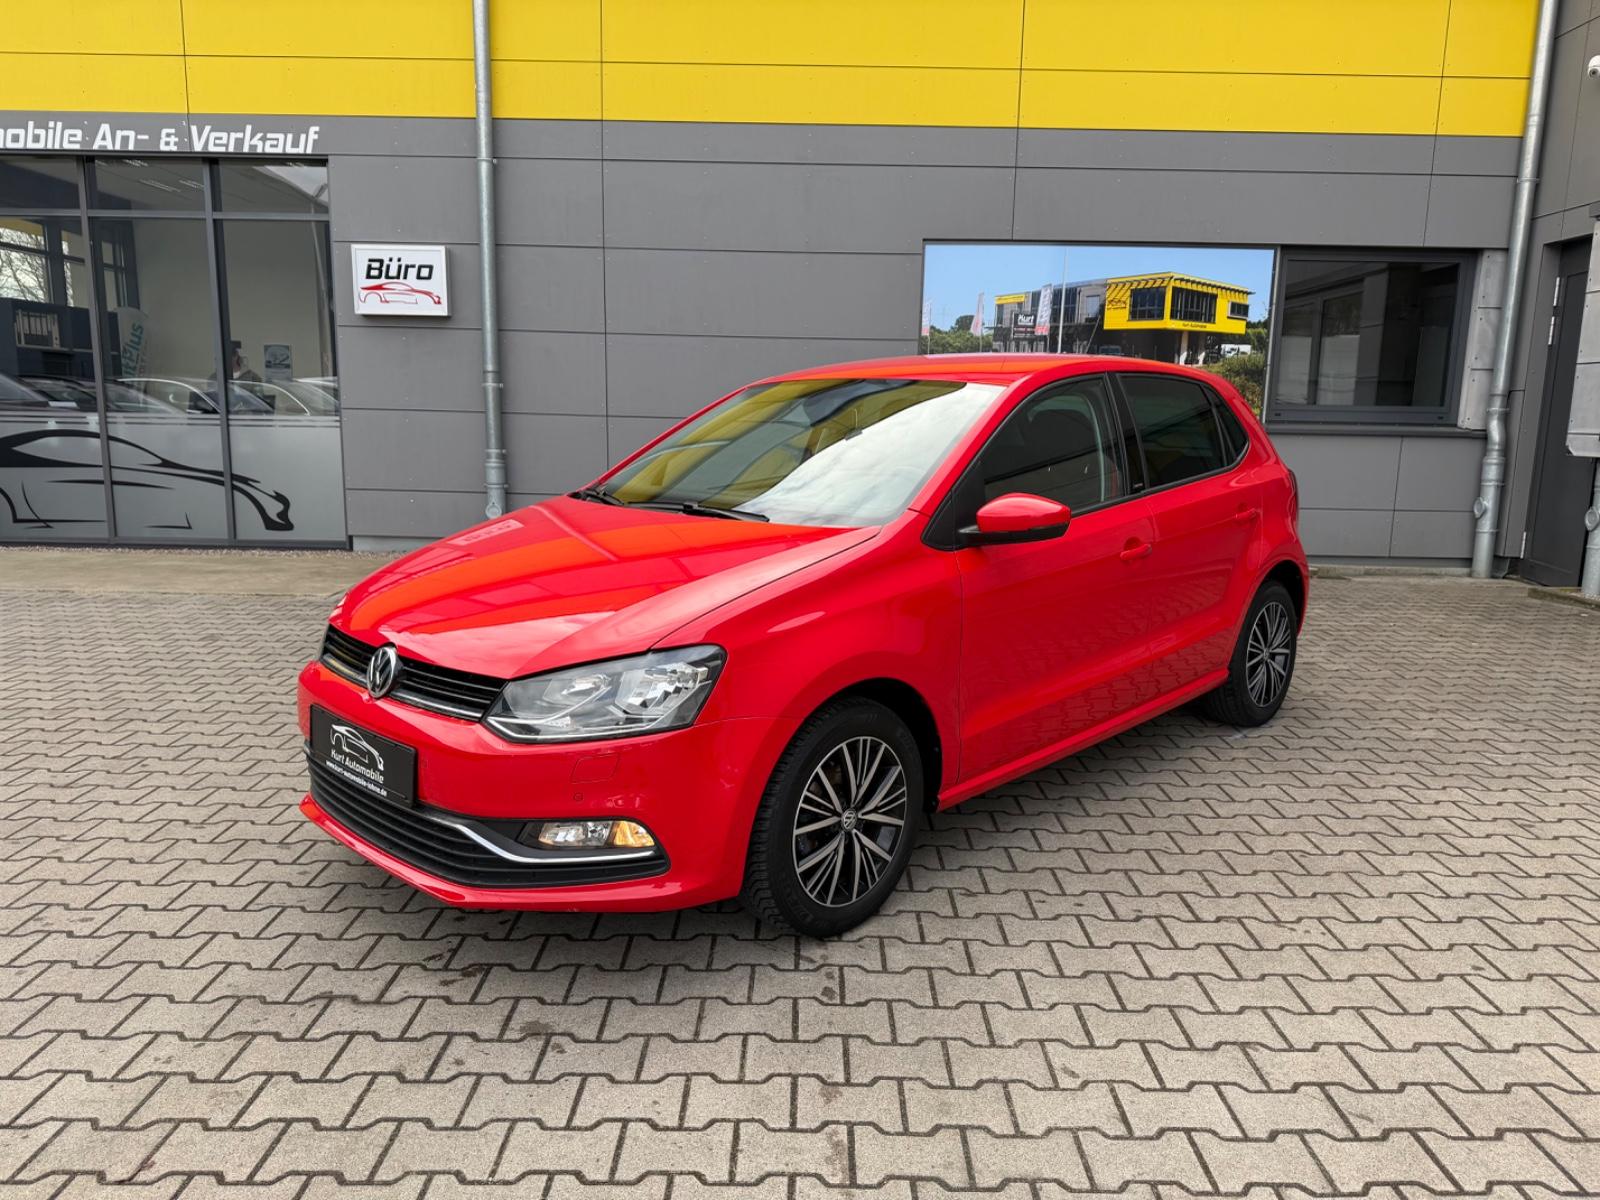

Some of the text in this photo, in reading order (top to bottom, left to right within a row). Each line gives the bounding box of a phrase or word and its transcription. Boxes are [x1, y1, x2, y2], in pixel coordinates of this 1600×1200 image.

[0, 120, 320, 154] obile An- & Verkauf
[365, 257, 434, 280] Büro
[330, 749, 385, 784] Kurt Automobile
